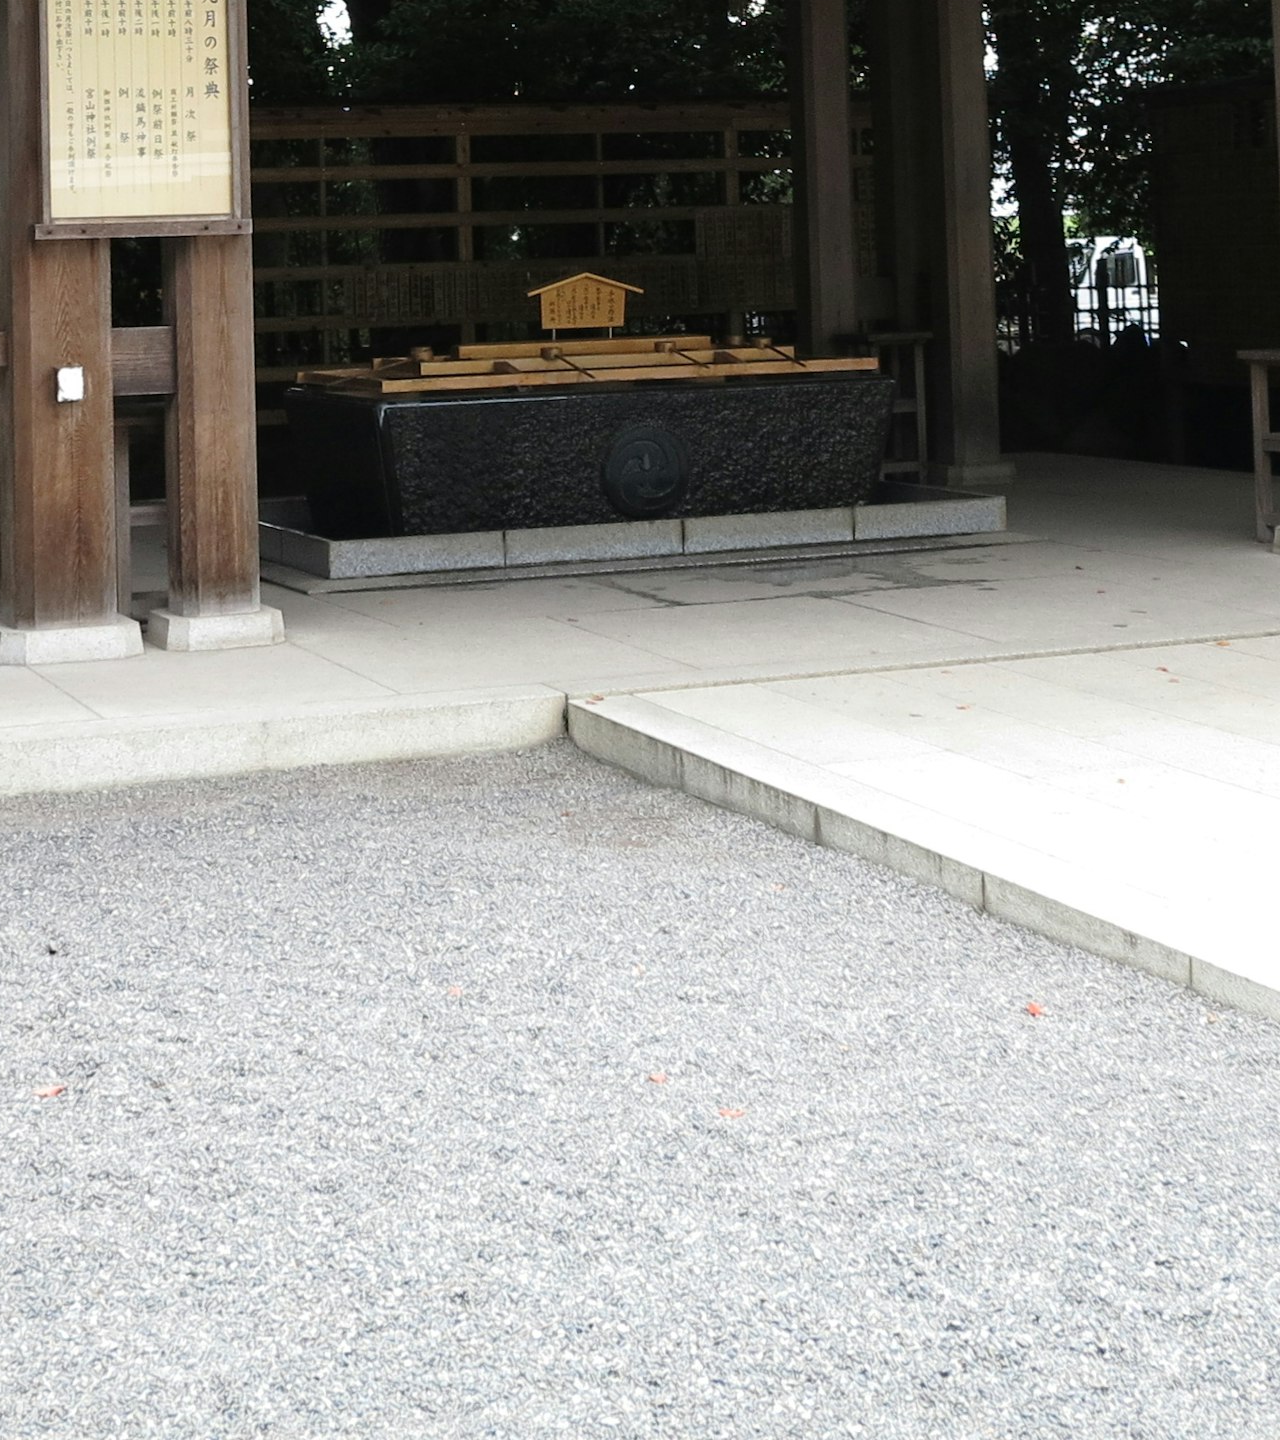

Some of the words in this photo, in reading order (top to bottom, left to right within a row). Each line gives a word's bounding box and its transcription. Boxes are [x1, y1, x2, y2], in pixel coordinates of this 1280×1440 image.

[84, 0, 94, 37] 午前十時
[100, 0, 111, 38] 午後一時
[118, 0, 128, 37] 午前十時
[134, 0, 144, 36] 午後二時
[150, 0, 161, 38] 午後一時
[167, 0, 177, 38] 午前十時
[182, 0, 194, 64] 午前八時三十分
[85, 88, 97, 160] 宮山神社例祭
[135, 87, 148, 159] 流鏑馬神事
[152, 88, 165, 160] 例祭前日祭
[185, 87, 198, 143] 月次祭
